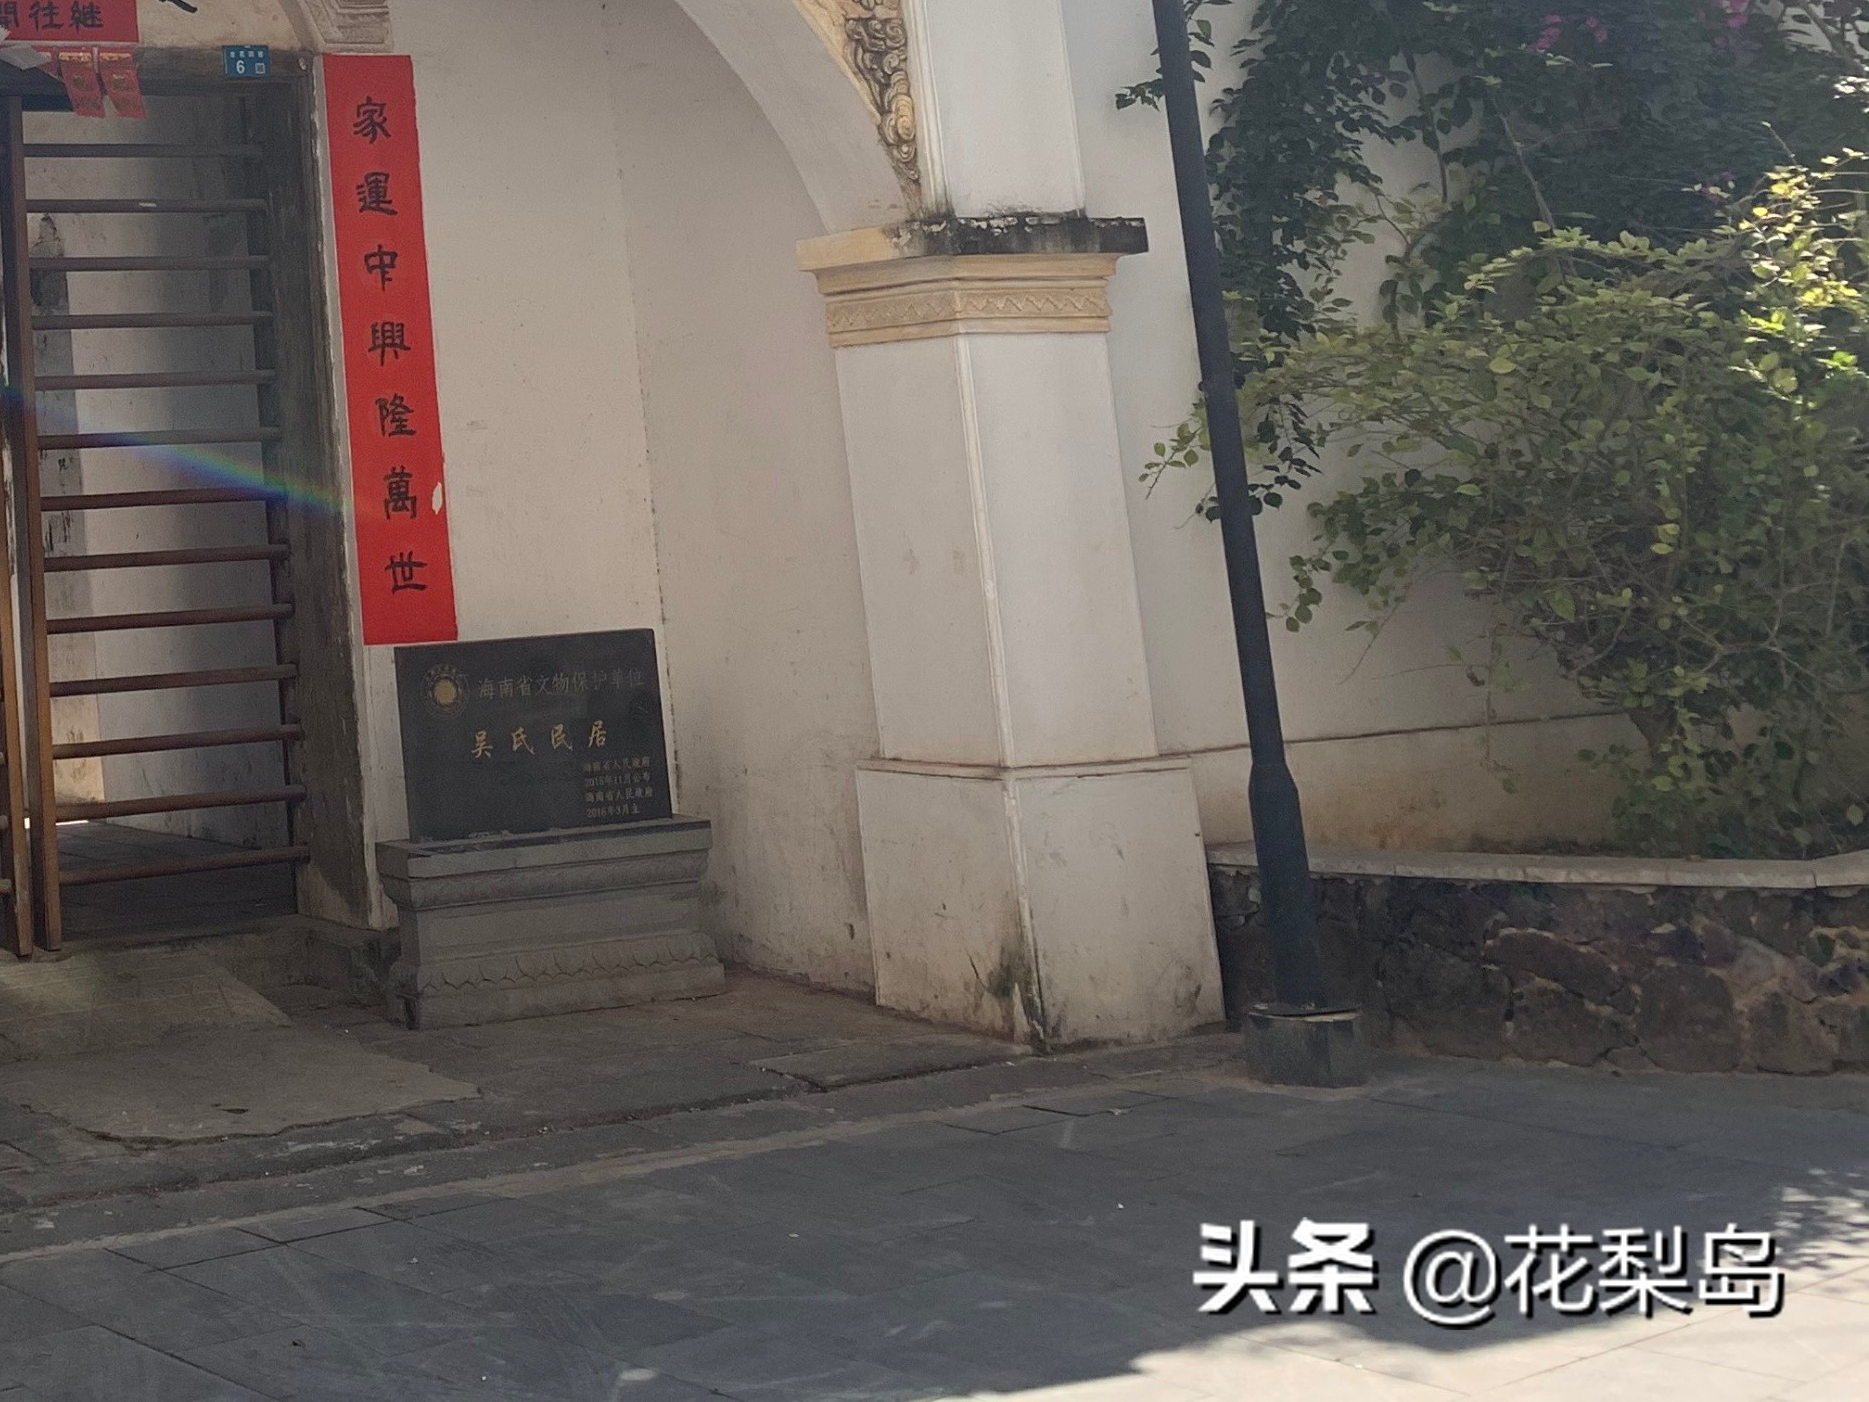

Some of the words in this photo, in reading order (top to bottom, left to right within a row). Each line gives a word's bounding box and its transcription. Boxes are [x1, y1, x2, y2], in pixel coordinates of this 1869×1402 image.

[236, 59, 245, 74] 6
[478, 667, 646, 700] 海南省文物保护单位
[471, 719, 609, 759] 吴氏民居
